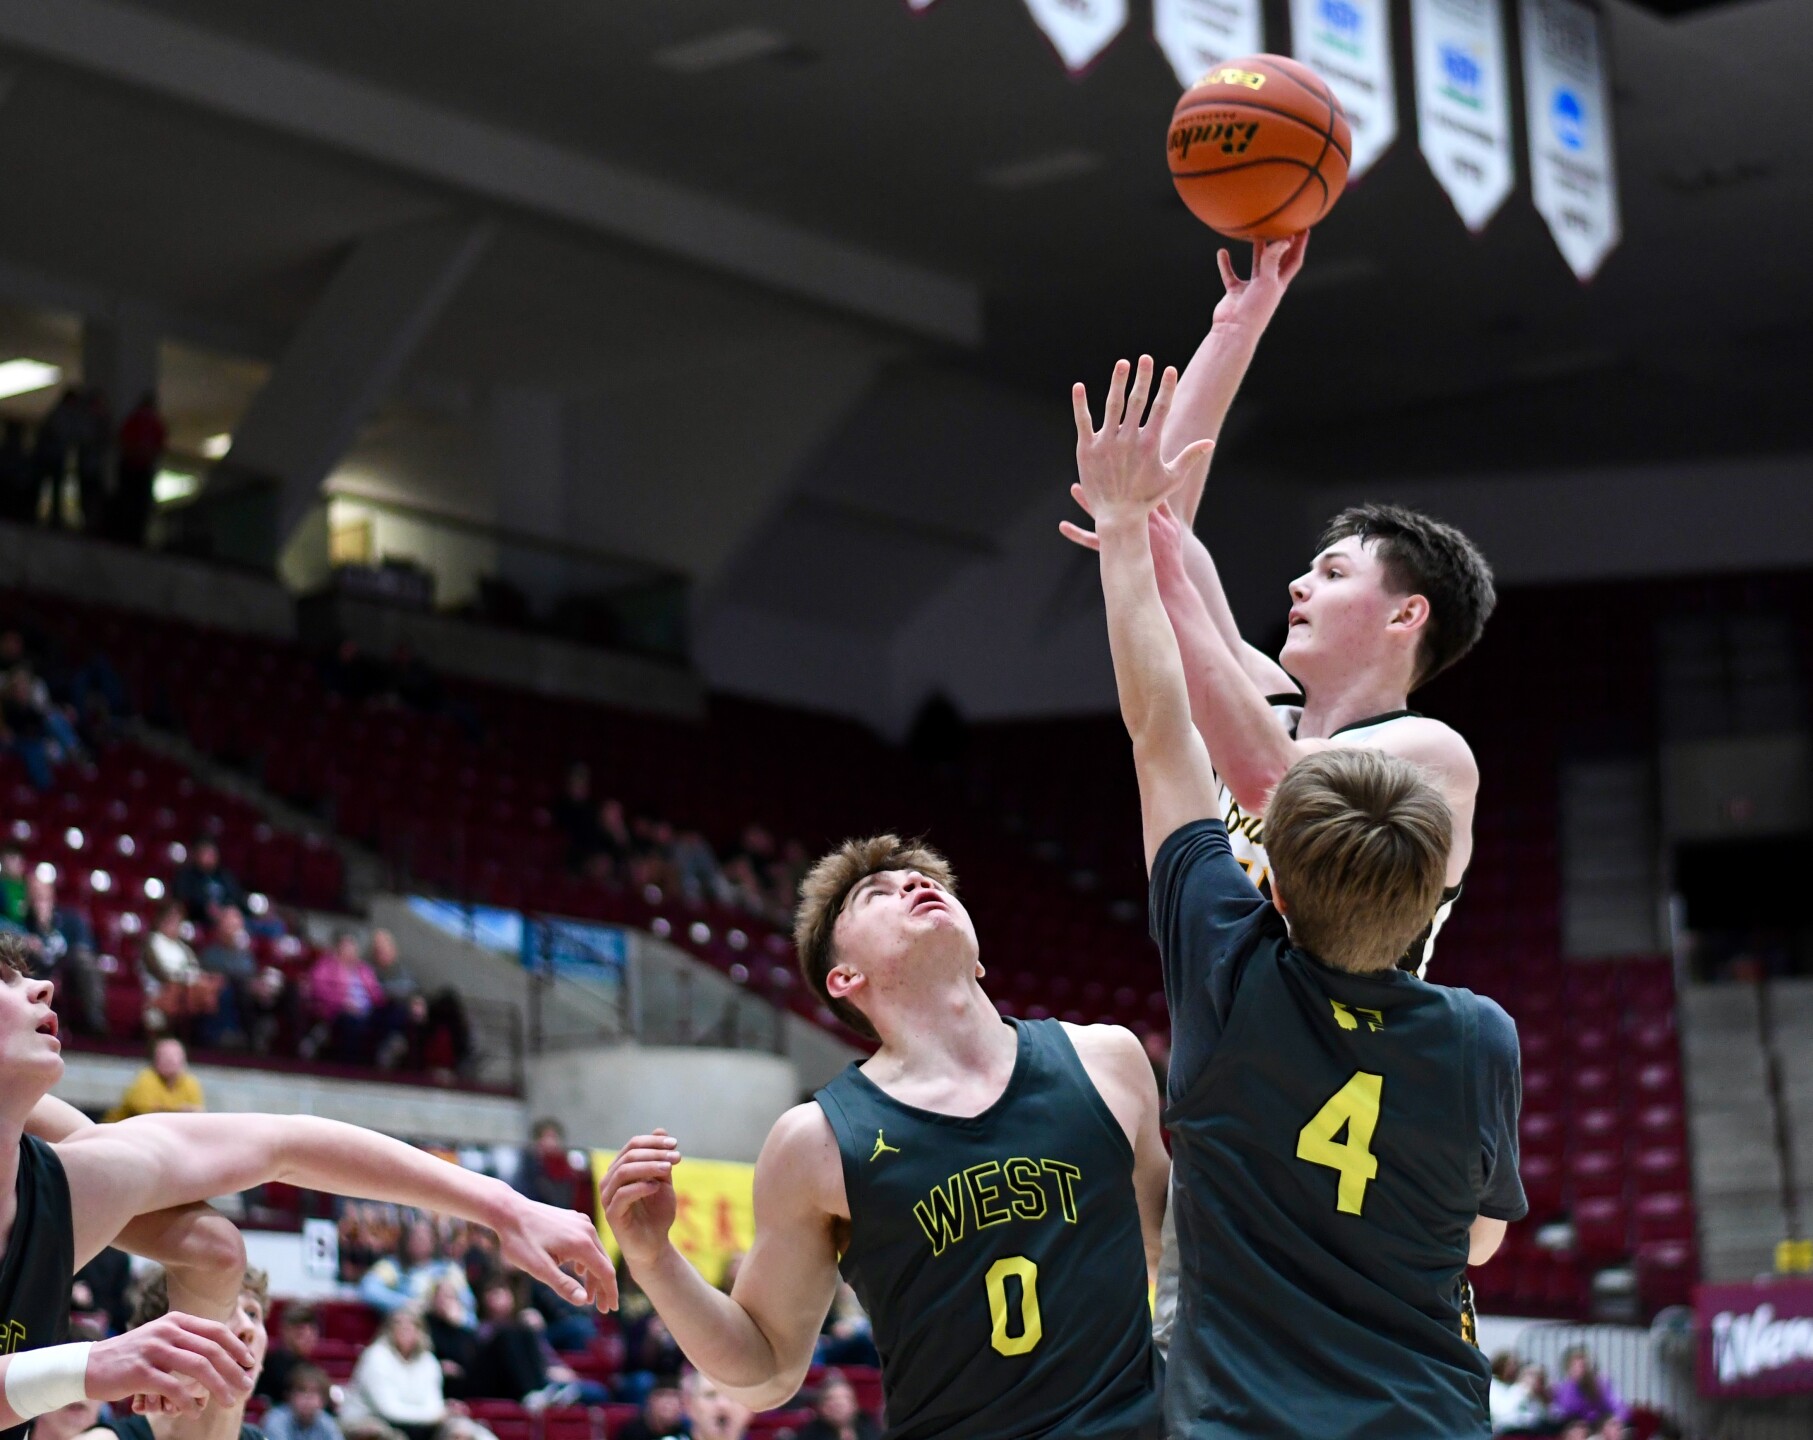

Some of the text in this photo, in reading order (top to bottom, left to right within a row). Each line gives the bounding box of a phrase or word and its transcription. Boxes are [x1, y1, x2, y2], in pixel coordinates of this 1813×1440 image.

[1295, 1069, 1384, 1217] 4
[912, 1156, 1081, 1257] WEST
[984, 1254, 1043, 1358] 0
